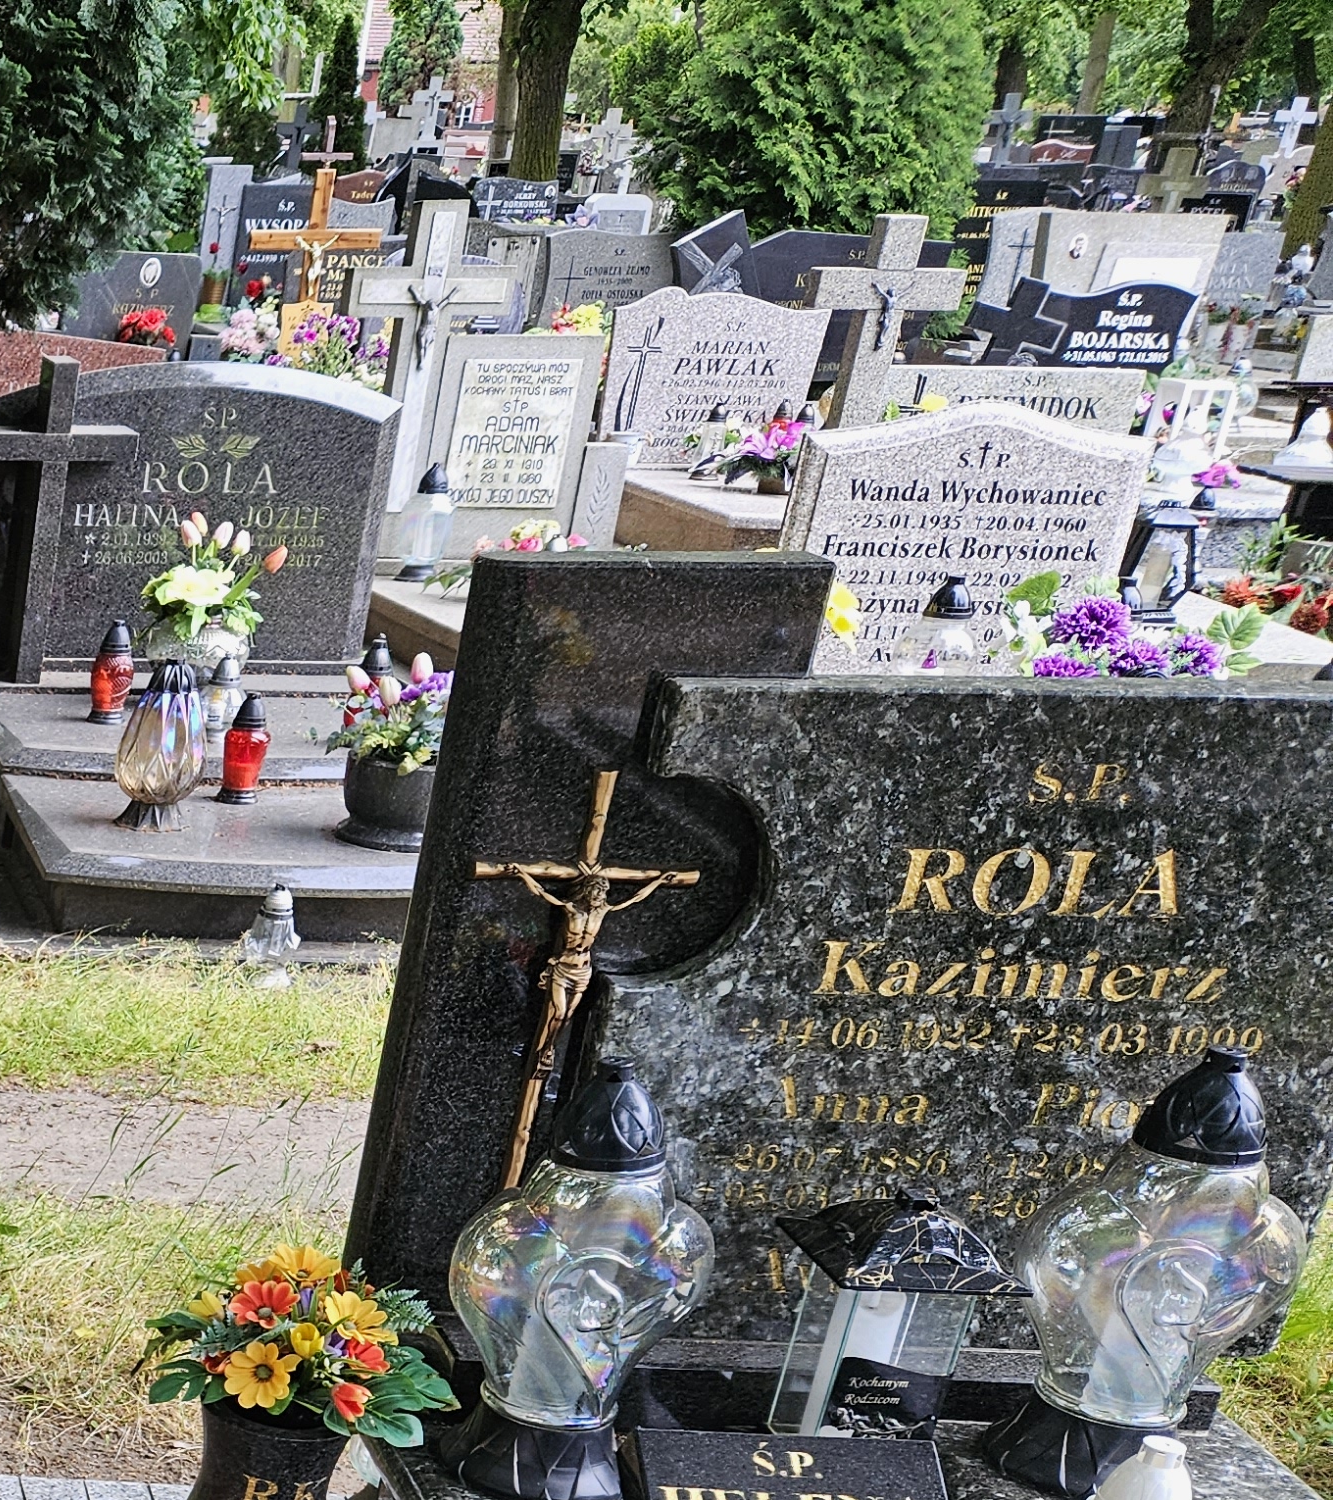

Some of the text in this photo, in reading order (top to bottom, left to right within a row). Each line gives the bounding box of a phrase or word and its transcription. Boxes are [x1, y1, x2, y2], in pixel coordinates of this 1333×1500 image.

[1096, 310, 1154, 331] Regina
[691, 341, 771, 355] MARIAN
[1068, 331, 1171, 350] BOJARSKA
[673, 358, 781, 376] PAWLAK
[485, 416, 540, 432] ADAM
[459, 435, 560, 455] MARCINIAK
[140, 460, 279, 495] ROLA
[485, 488, 514, 504] JEGO
[517, 488, 555, 504] DUSZY
[849, 478, 1108, 512] Wanda Wychowaniec
[73, 502, 331, 529] HALINA JÓZEF
[860, 513, 1087, 532] 25.01.1935 20.04.1960
[821, 534, 1099, 568] Franciszek Borysionek
[845, 570, 949, 586] 22.11.1949
[886, 848, 1185, 921] ROLA
[811, 940, 1229, 1004] Kazimierz
[848, 1376, 910, 1391] Kochanym
[844, 1393, 901, 1406] Rodzicom
[752, 1442, 824, 1480] Ś.P.
